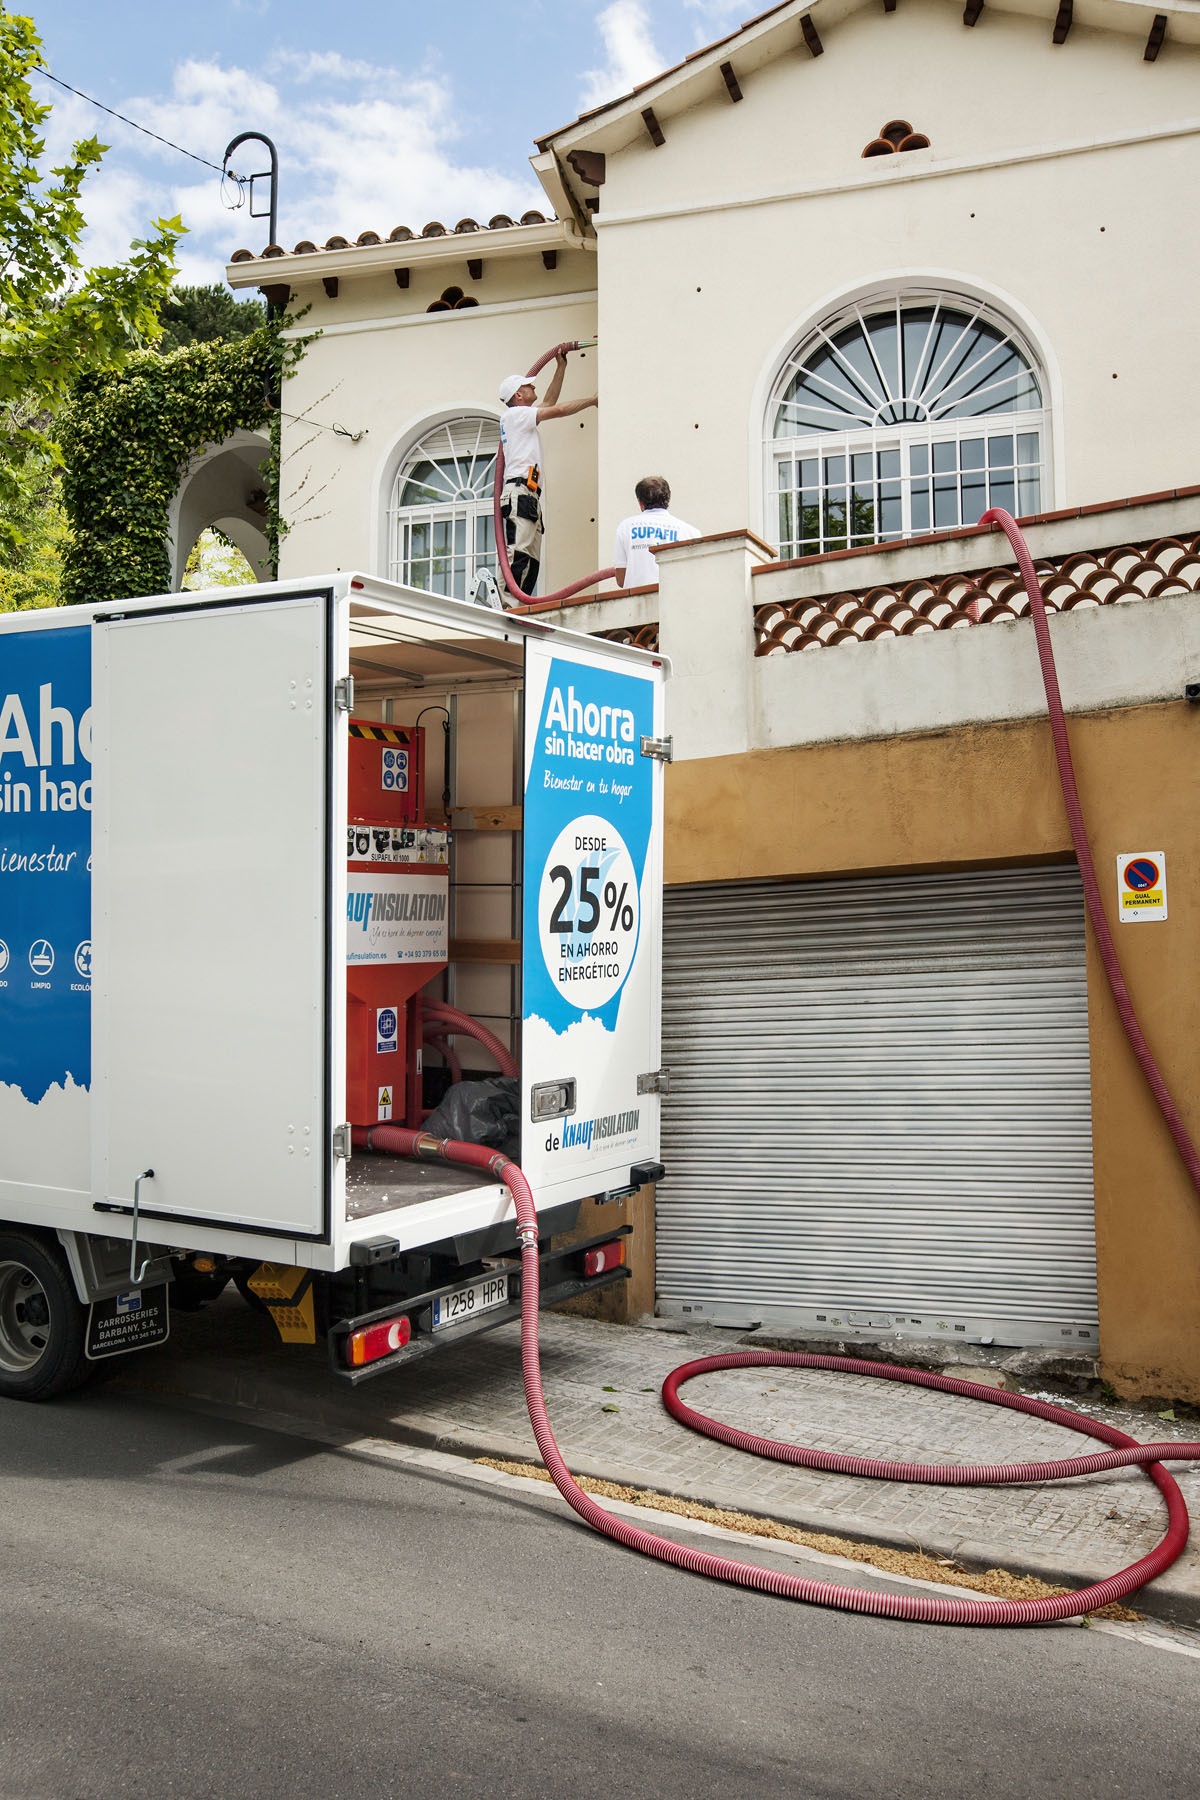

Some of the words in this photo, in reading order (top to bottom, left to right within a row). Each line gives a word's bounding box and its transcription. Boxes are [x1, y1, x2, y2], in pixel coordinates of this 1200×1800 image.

[631, 526, 679, 542] SUPAFIL
[545, 686, 634, 742] Ahorra
[545, 731, 565, 756] sin
[568, 733, 604, 761] hacer
[606, 740, 634, 765] obra
[0, 771, 31, 813] in
[543, 770, 583, 791] Bienestar
[586, 782, 595, 792] en
[599, 778, 608, 794] tu
[611, 779, 632, 804] hogar
[575, 836, 607, 852] DESDE
[371, 853, 392, 862] SUPAFIL
[549, 865, 634, 934] 25%
[560, 943, 574, 958] EN
[577, 941, 619, 957] AHORRO
[559, 962, 620, 982] ENERGÉTICO
[31, 982, 51, 990] LIMPIO
[70, 982, 91, 992] ECOLÓ
[545, 1133, 559, 1152] de
[445, 1289, 475, 1318] 1258
[483, 1279, 504, 1305] HPR
[98, 1307, 159, 1329] CARROSSERIES
[99, 1323, 140, 1340] BARBANY,
[141, 1319, 157, 1329] S.A.
[92, 1337, 126, 1350] BARCELONA
